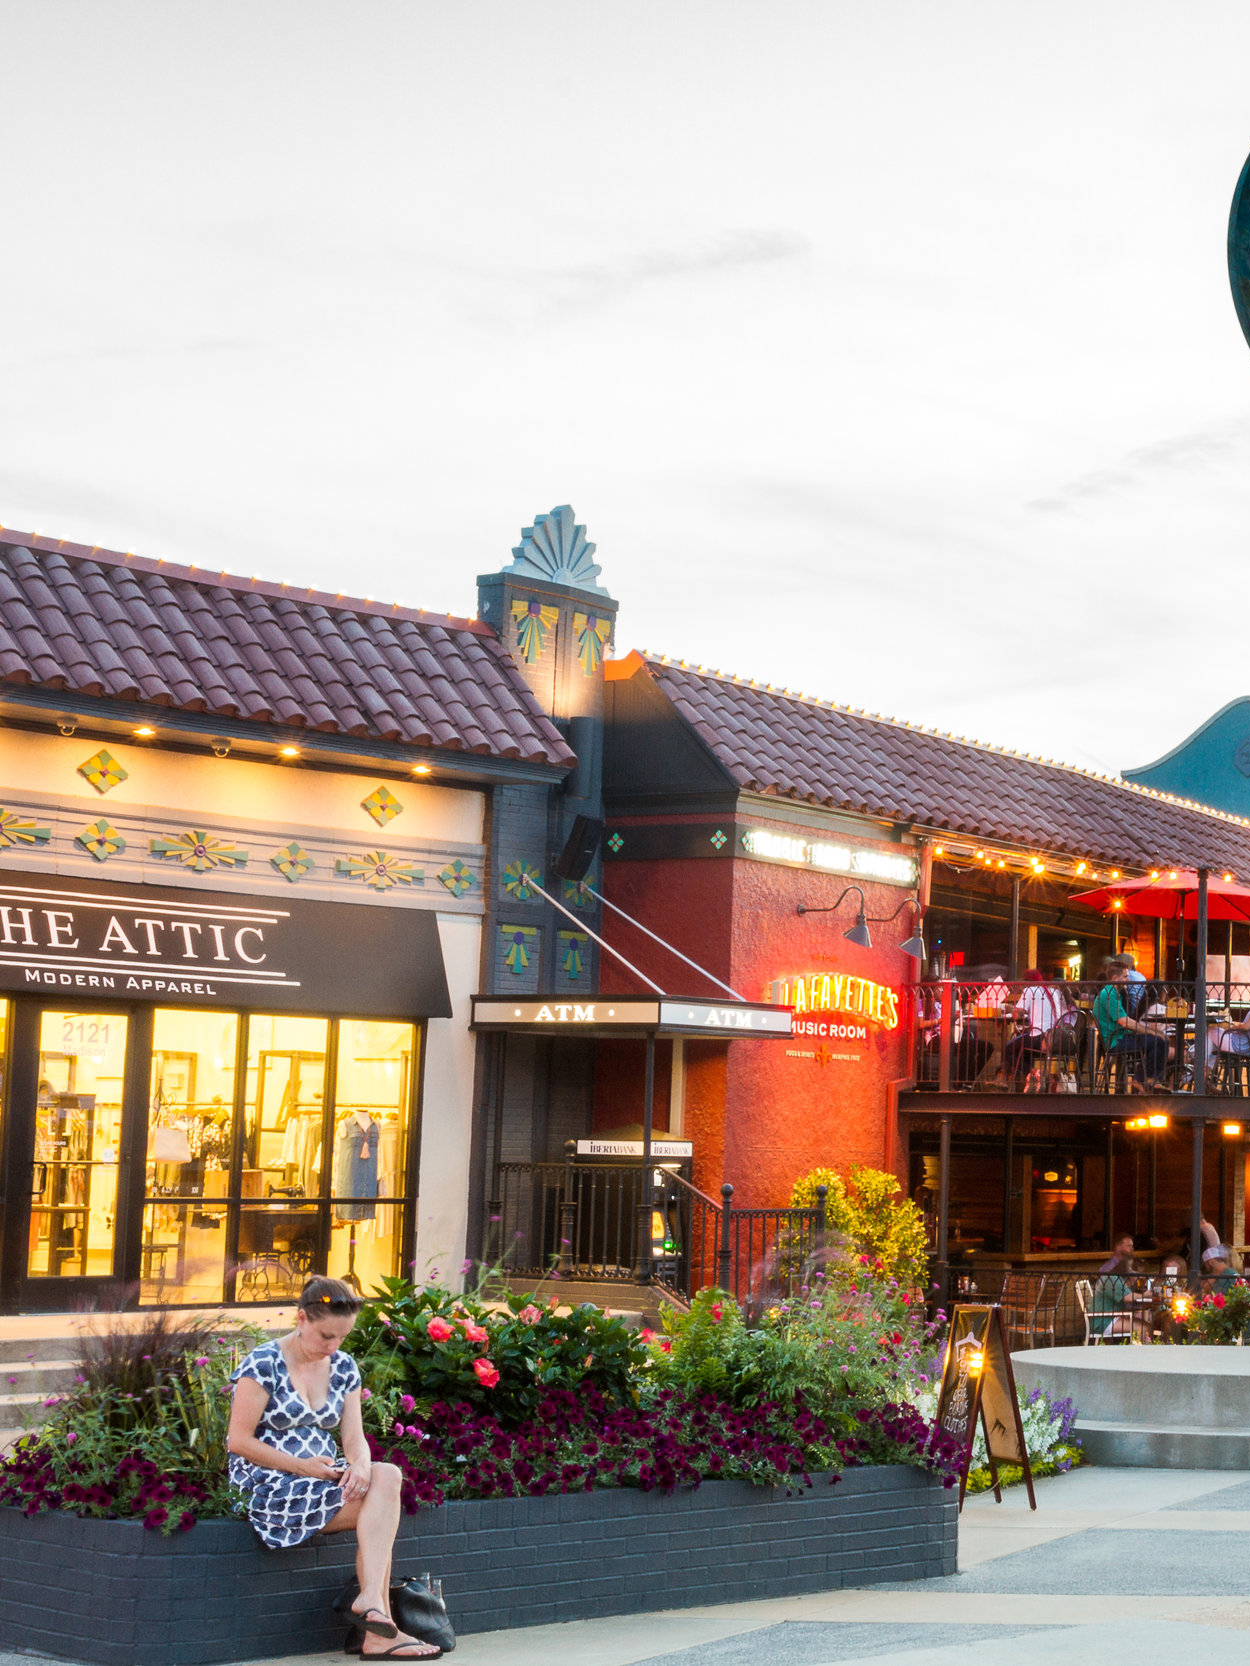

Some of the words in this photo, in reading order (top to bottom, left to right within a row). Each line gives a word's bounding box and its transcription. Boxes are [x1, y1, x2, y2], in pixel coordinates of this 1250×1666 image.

[0, 906, 79, 949] HE
[98, 915, 267, 964] ATTIC
[24, 968, 115, 988] MODERN
[126, 976, 217, 996] APPAREL
[534, 1004, 596, 1021] ATM
[783, 974, 899, 1029] LAFAYETTE'S
[704, 1008, 753, 1028] ATM
[62, 1021, 110, 1044] 2121
[829, 1023, 866, 1039] ROOM
